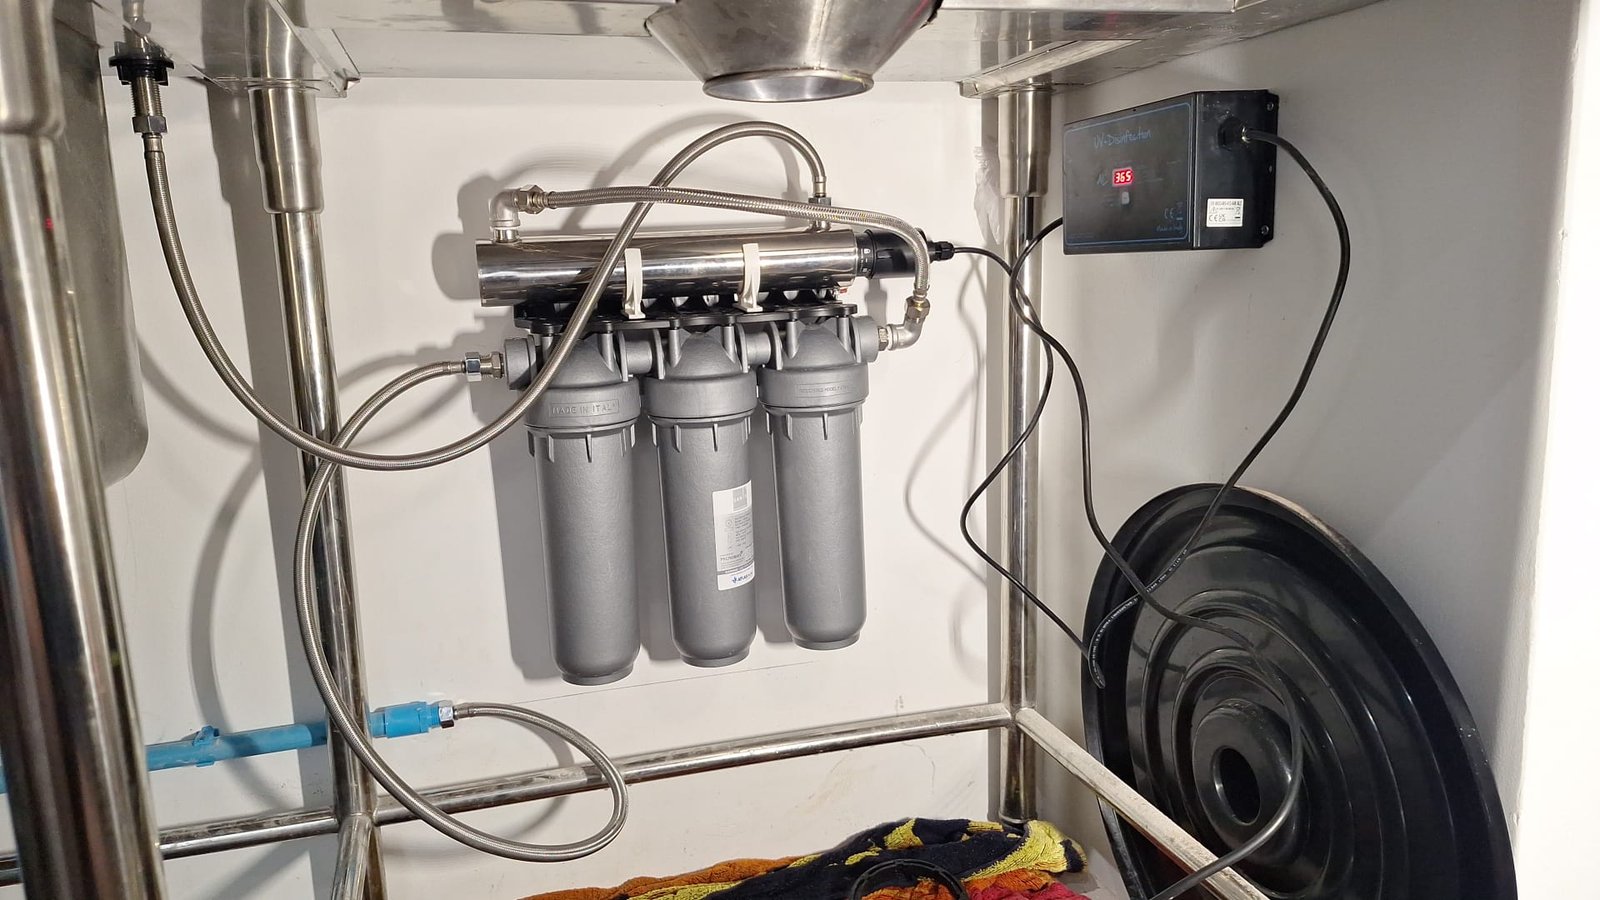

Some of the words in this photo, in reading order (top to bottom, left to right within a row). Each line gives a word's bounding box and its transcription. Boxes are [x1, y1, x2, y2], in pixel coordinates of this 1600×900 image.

[1115, 170, 1131, 183] 365
[552, 406, 577, 415] MADE
[580, 405, 589, 414] IN
